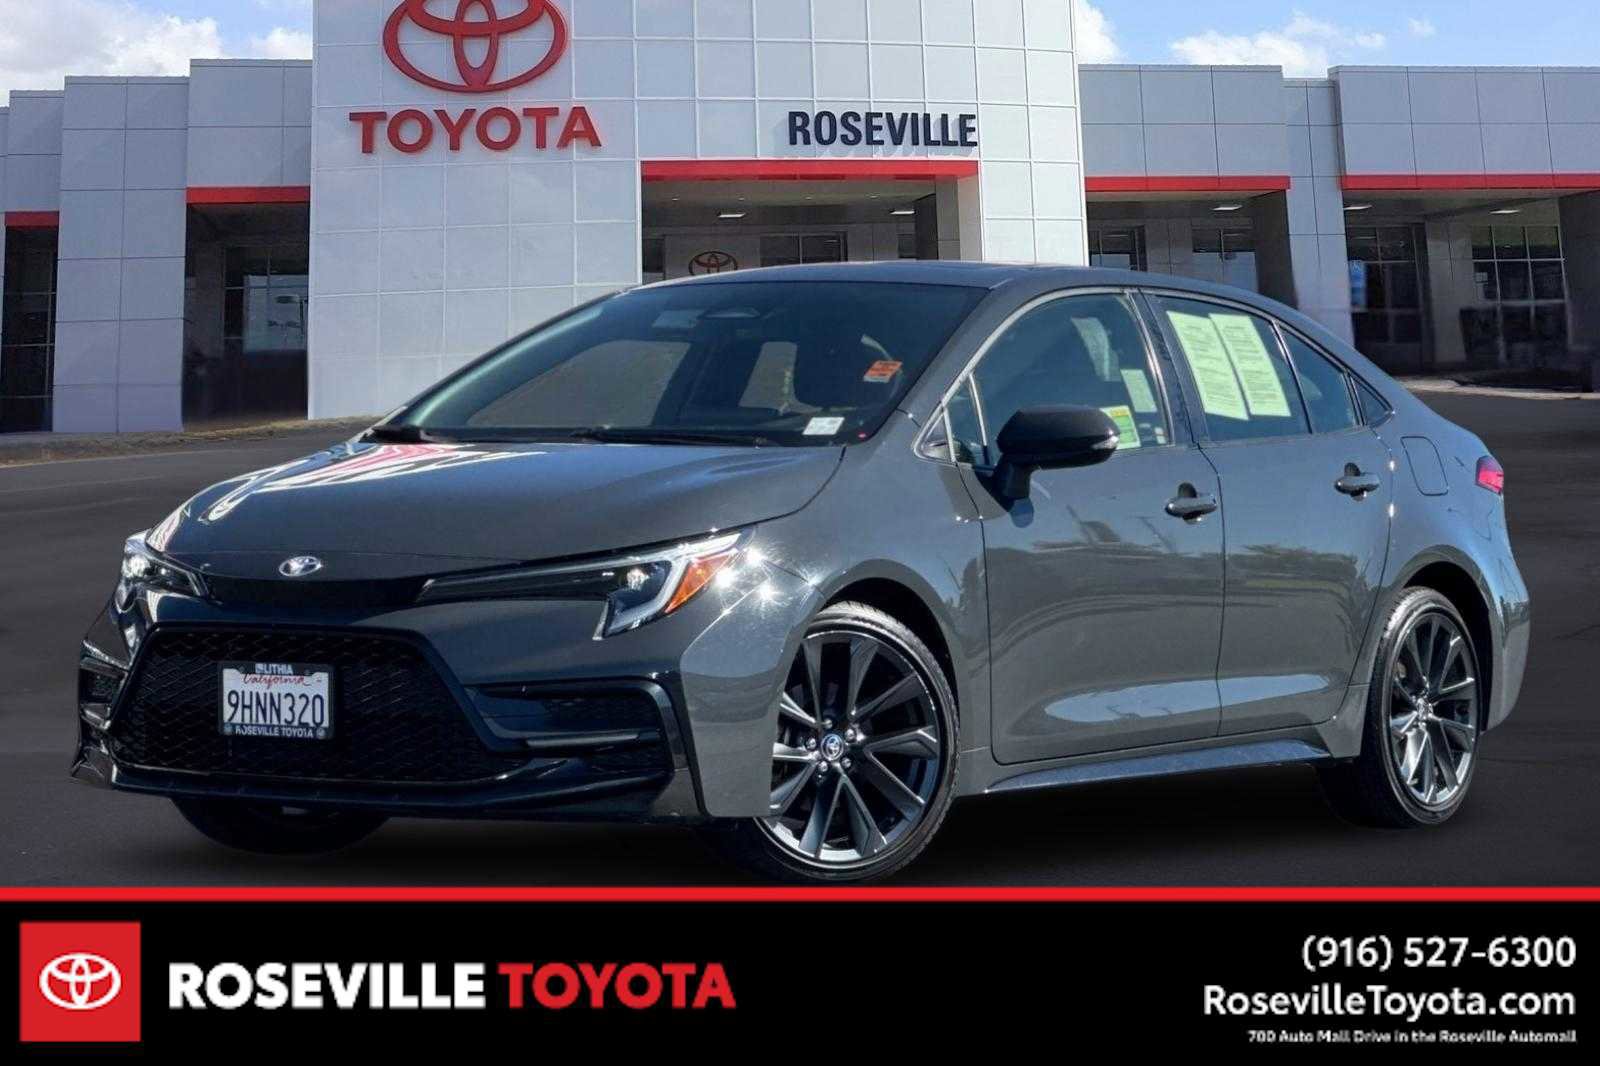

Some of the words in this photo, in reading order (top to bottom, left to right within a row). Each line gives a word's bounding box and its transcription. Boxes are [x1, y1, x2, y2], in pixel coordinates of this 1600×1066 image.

[350, 107, 602, 153] TOYOTA
[789, 111, 977, 146] ROSEVILLE
[243, 673, 311, 689] California
[227, 690, 324, 727] 9HNN320
[235, 726, 280, 737] ROSEVILLE
[281, 727, 313, 738] TOYOTA
